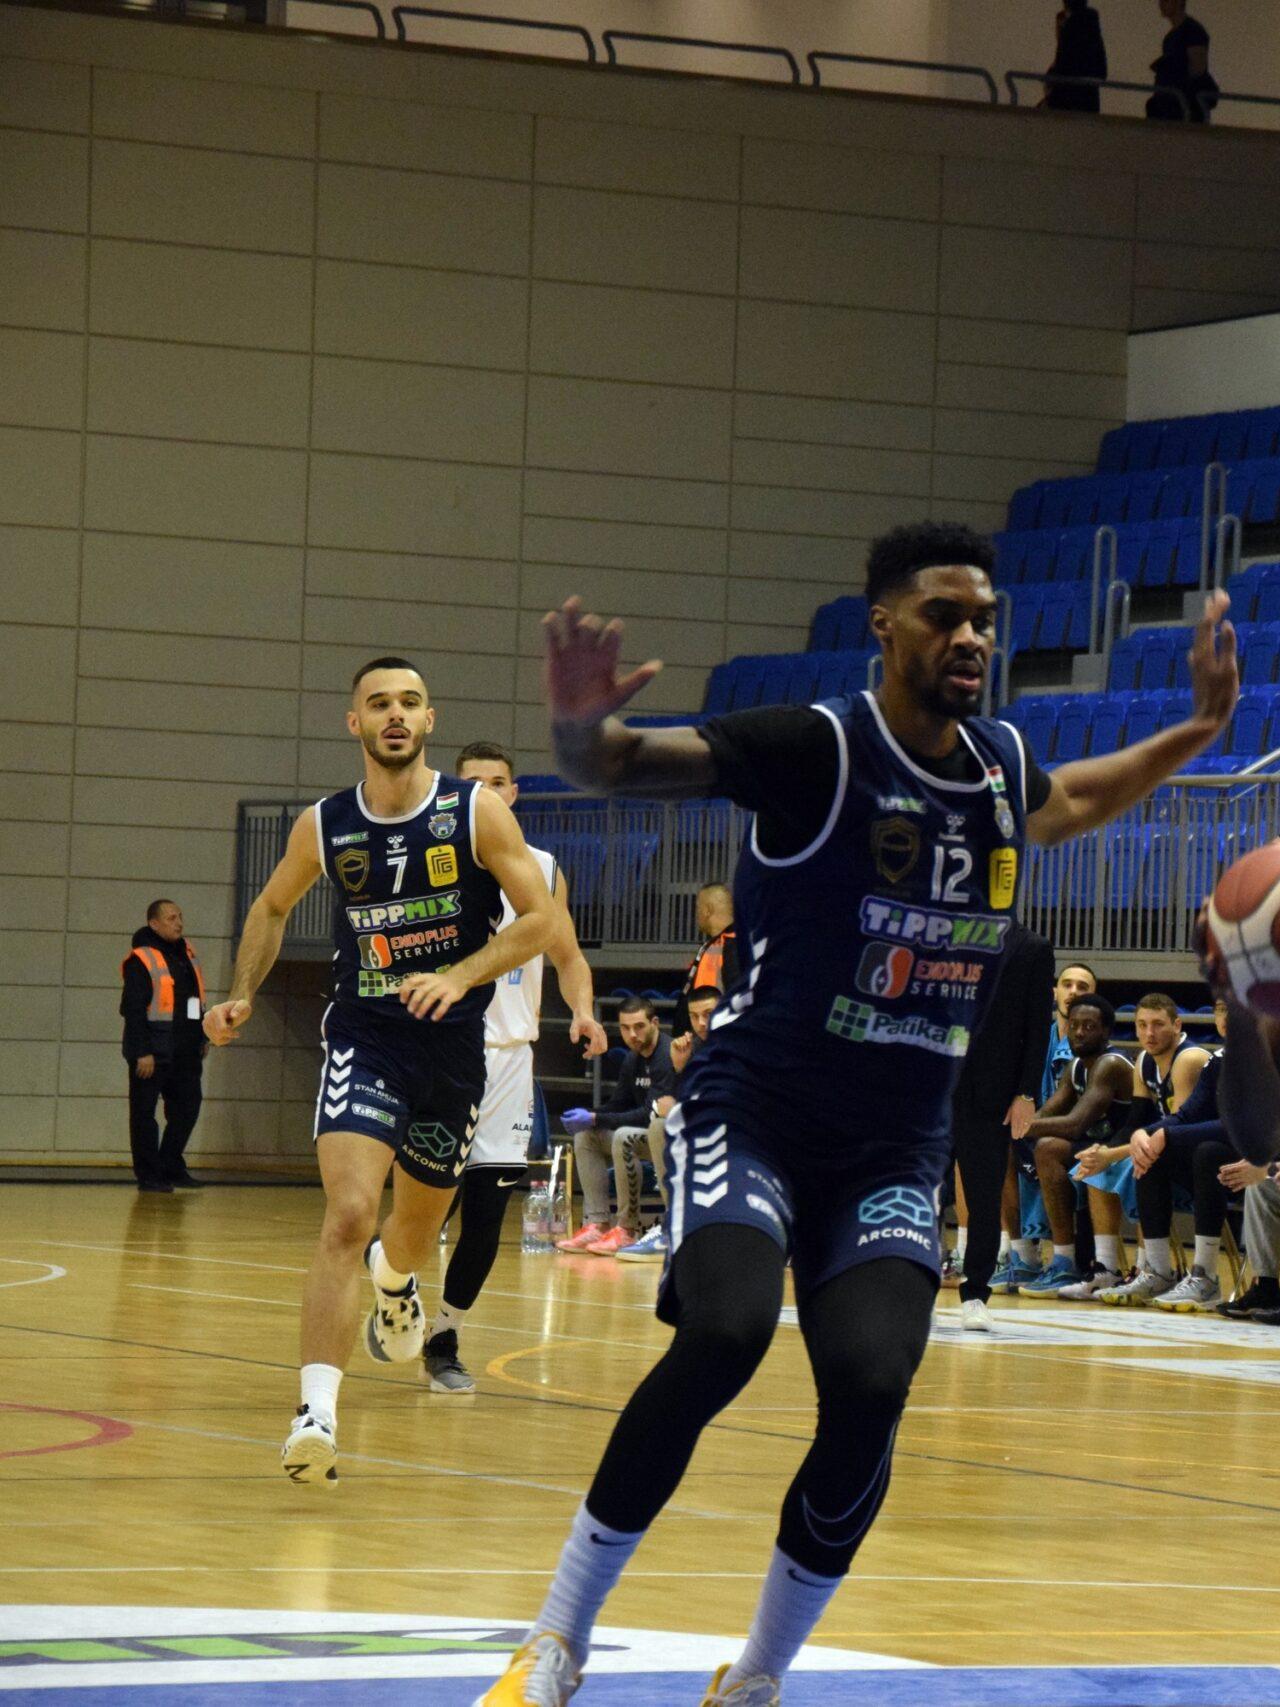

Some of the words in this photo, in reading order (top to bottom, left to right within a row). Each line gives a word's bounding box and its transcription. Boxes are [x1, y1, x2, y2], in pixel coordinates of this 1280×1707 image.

[387, 856, 408, 894] 7
[930, 846, 973, 903] 12
[394, 938, 460, 960] SERVICE
[401, 1144, 448, 1172] ARCONIC
[857, 1227, 932, 1250] ARCONIC
